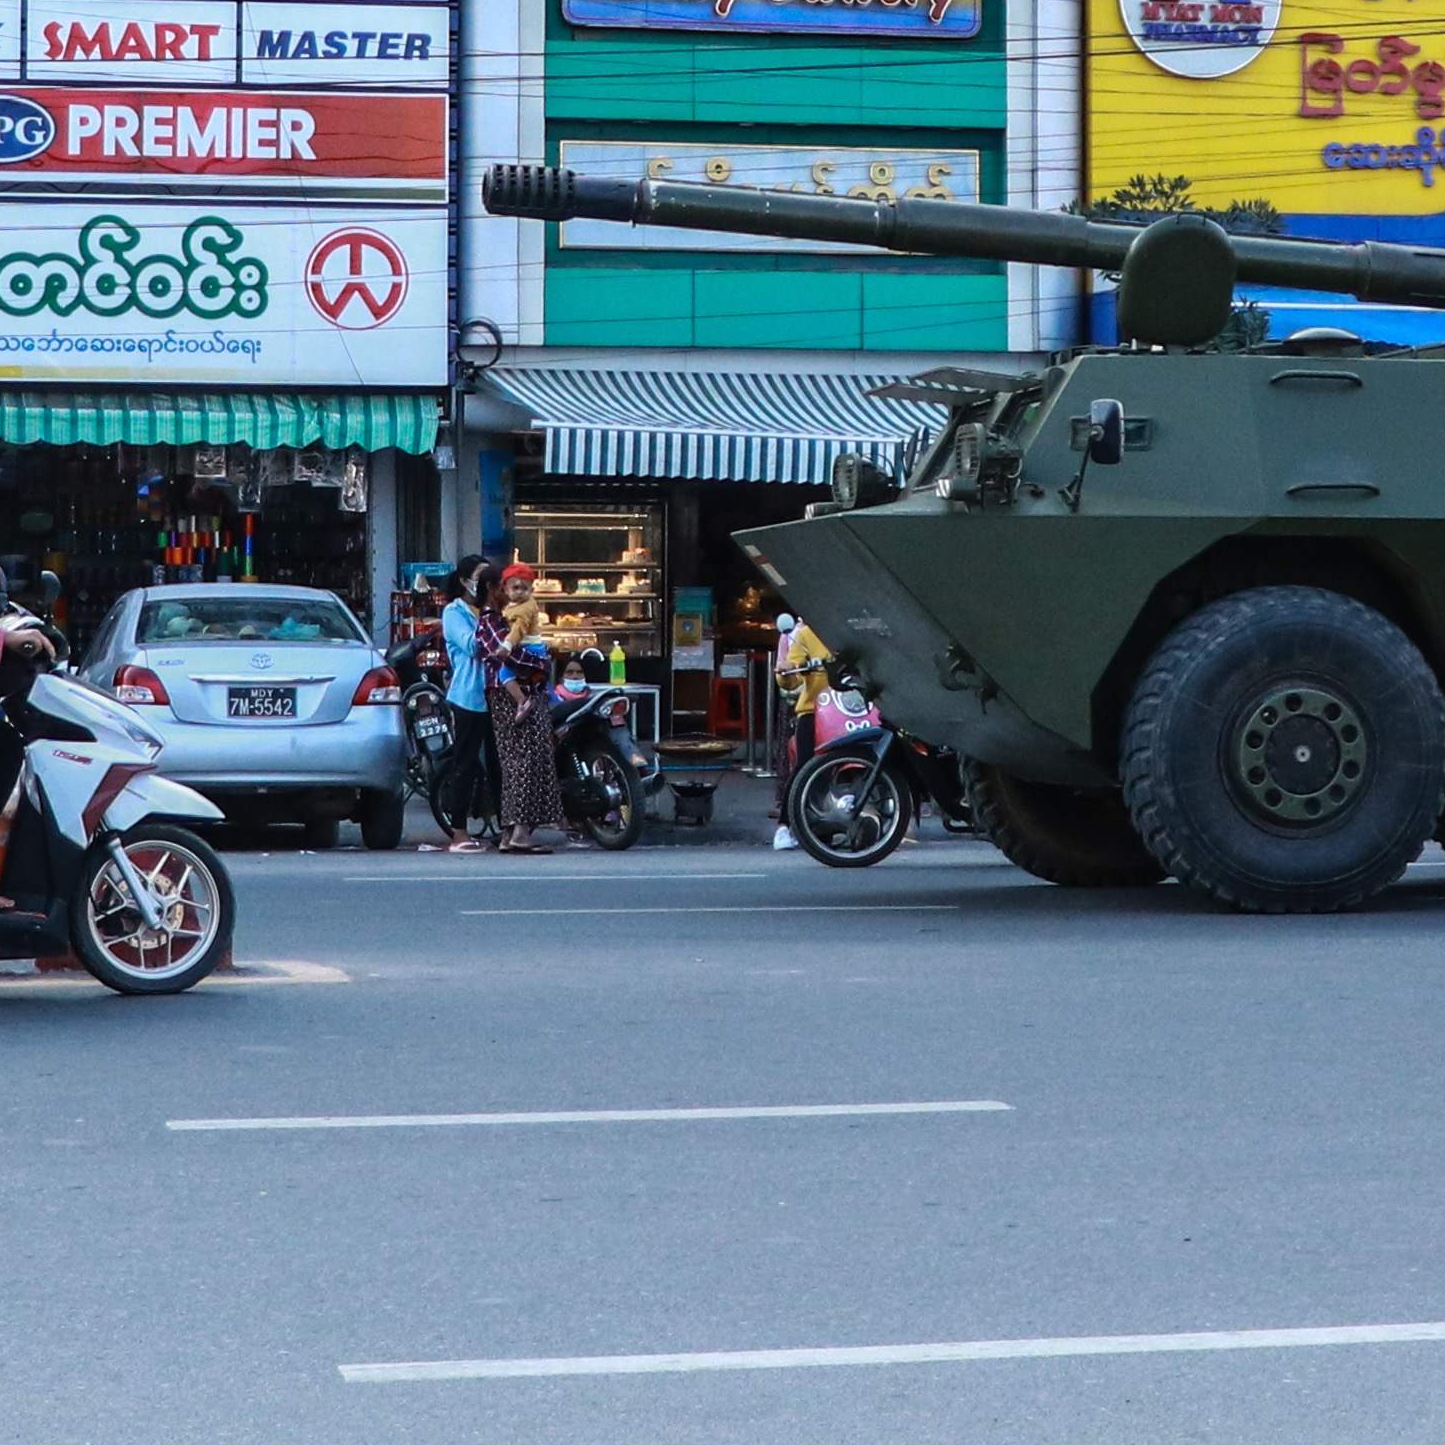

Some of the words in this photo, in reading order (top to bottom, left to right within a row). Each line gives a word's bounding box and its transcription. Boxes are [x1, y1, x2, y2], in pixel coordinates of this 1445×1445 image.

[1141, 1, 1205, 22] MYAT
[1210, 4, 1264, 24] MON
[44, 21, 222, 61] SMART
[257, 30, 432, 61] MASTER
[68, 104, 316, 160] PREMIER
[230, 698, 293, 716] 7M-5542
[250, 689, 275, 698] MDY
